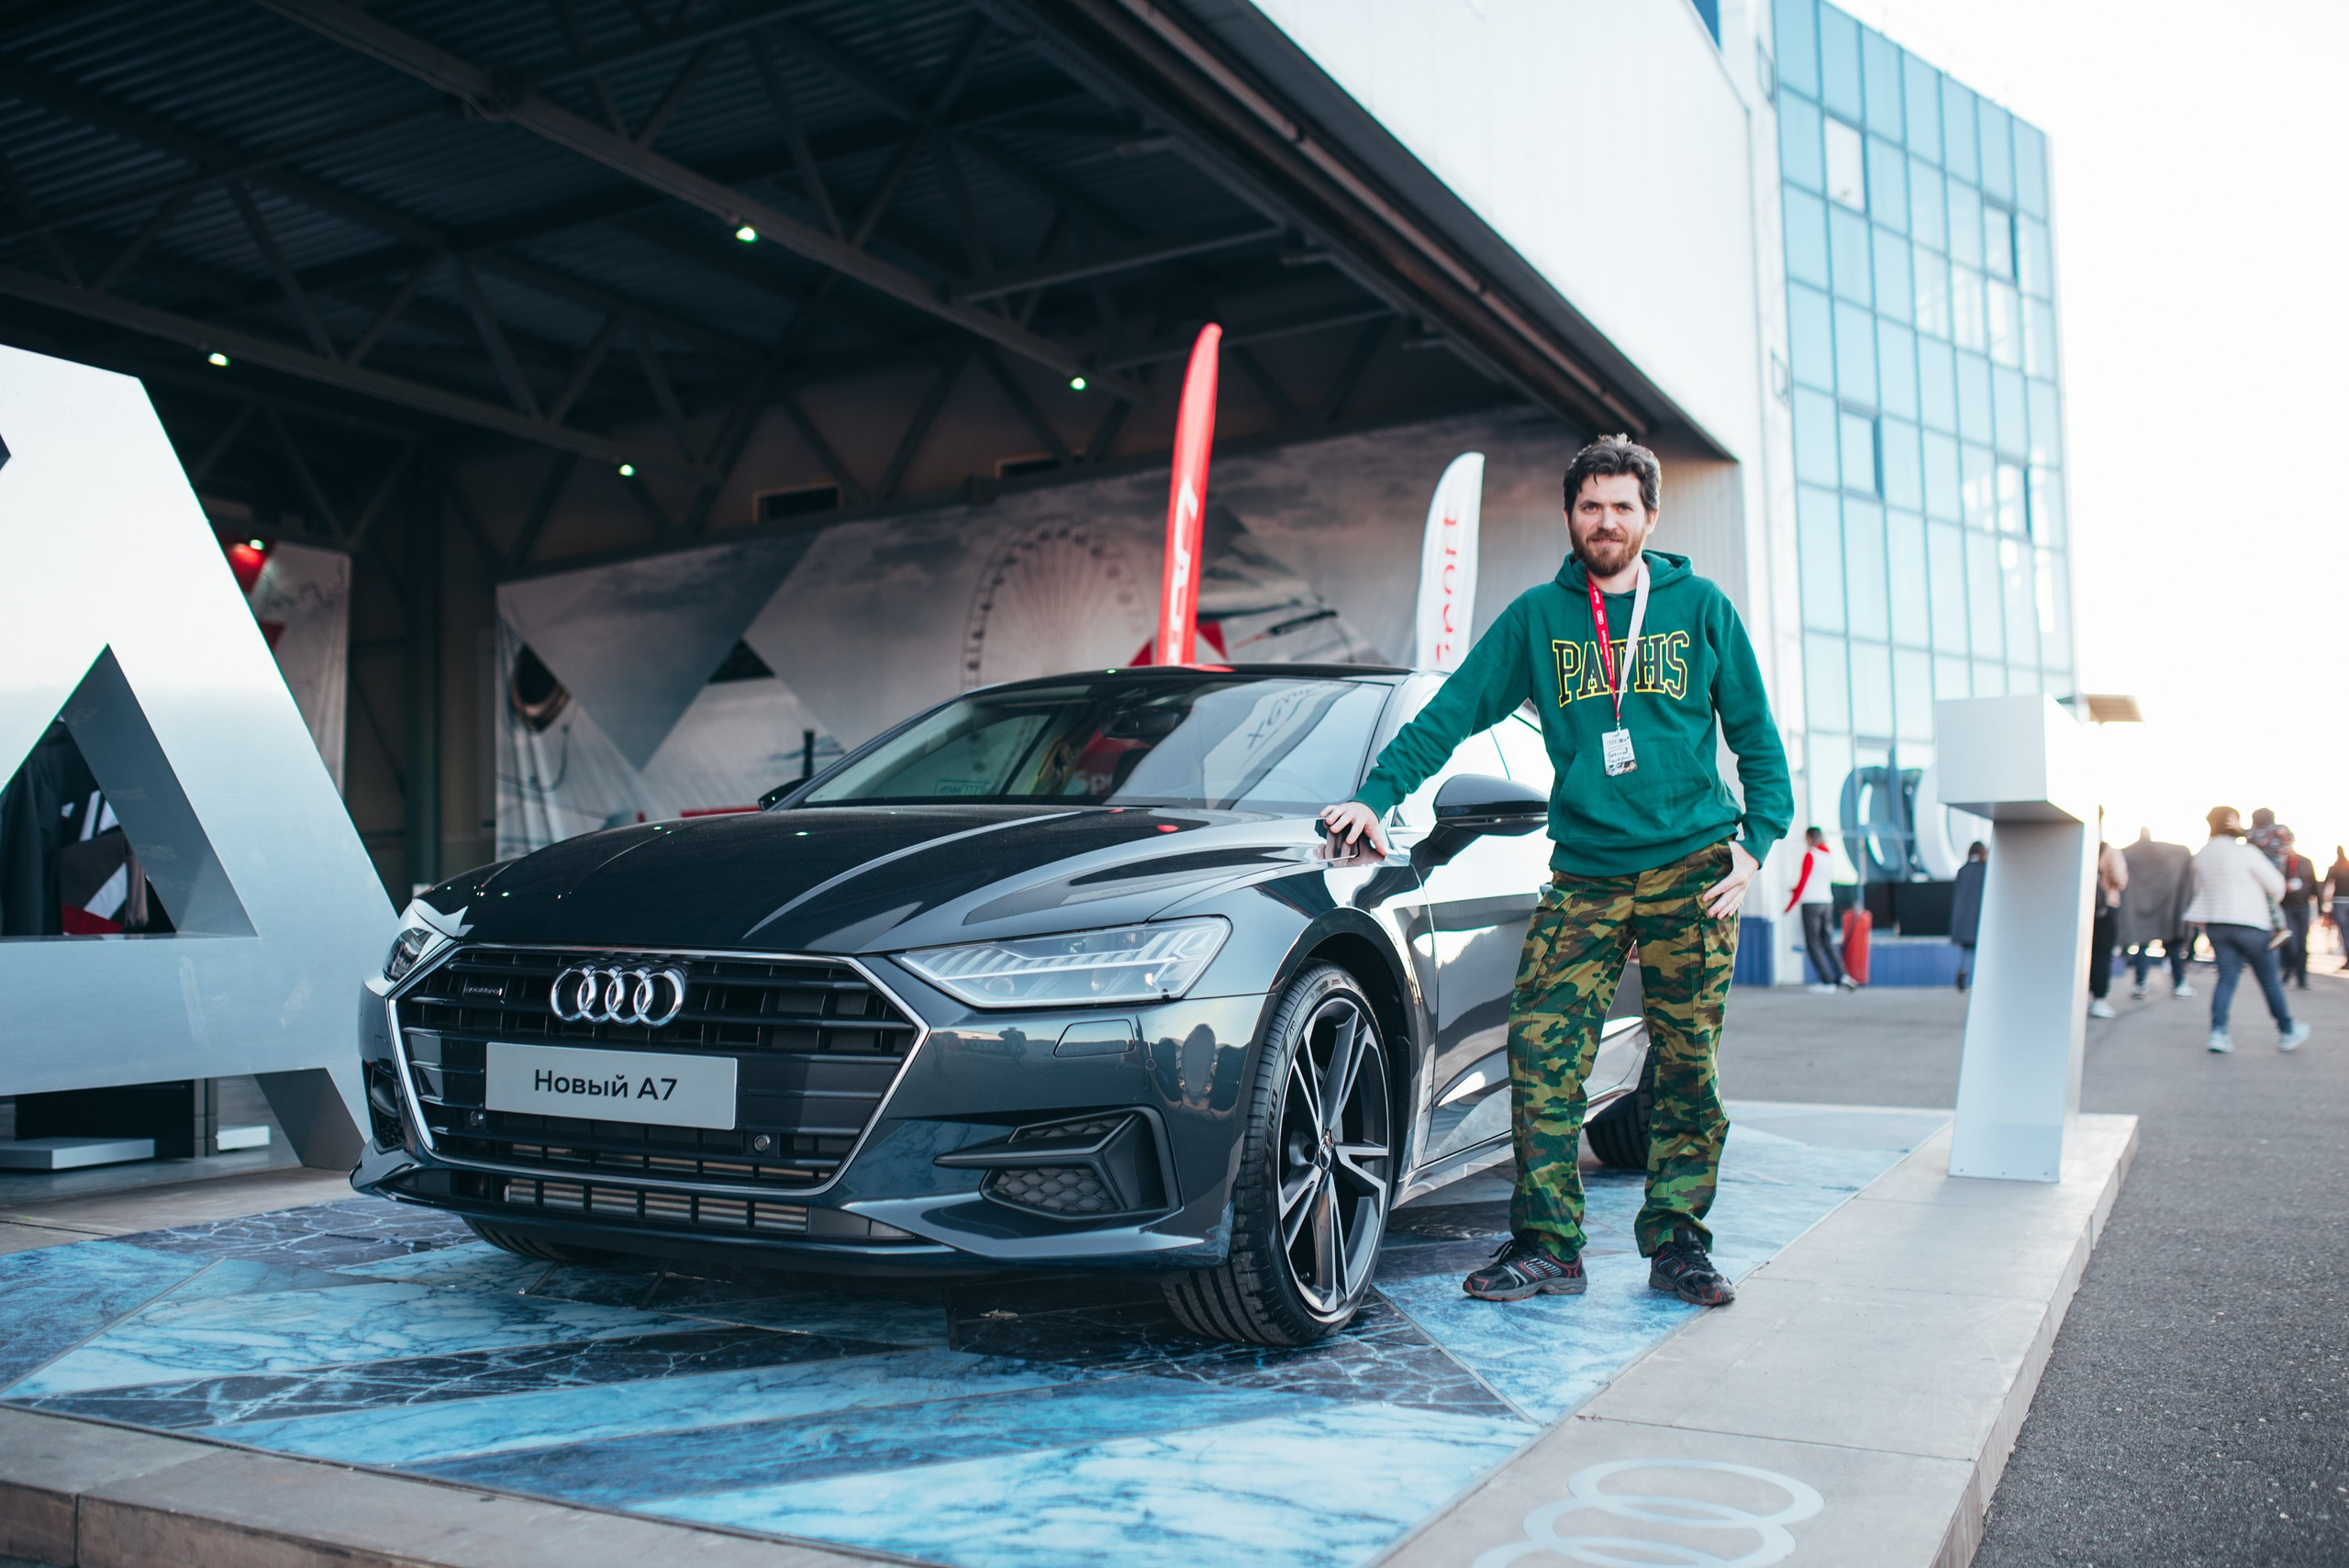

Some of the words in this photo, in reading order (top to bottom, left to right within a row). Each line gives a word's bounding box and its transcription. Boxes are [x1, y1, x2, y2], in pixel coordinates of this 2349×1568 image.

[1553, 630, 1690, 707] PATHS
[534, 1069, 629, 1098] Новый
[637, 1076, 678, 1101] A7
